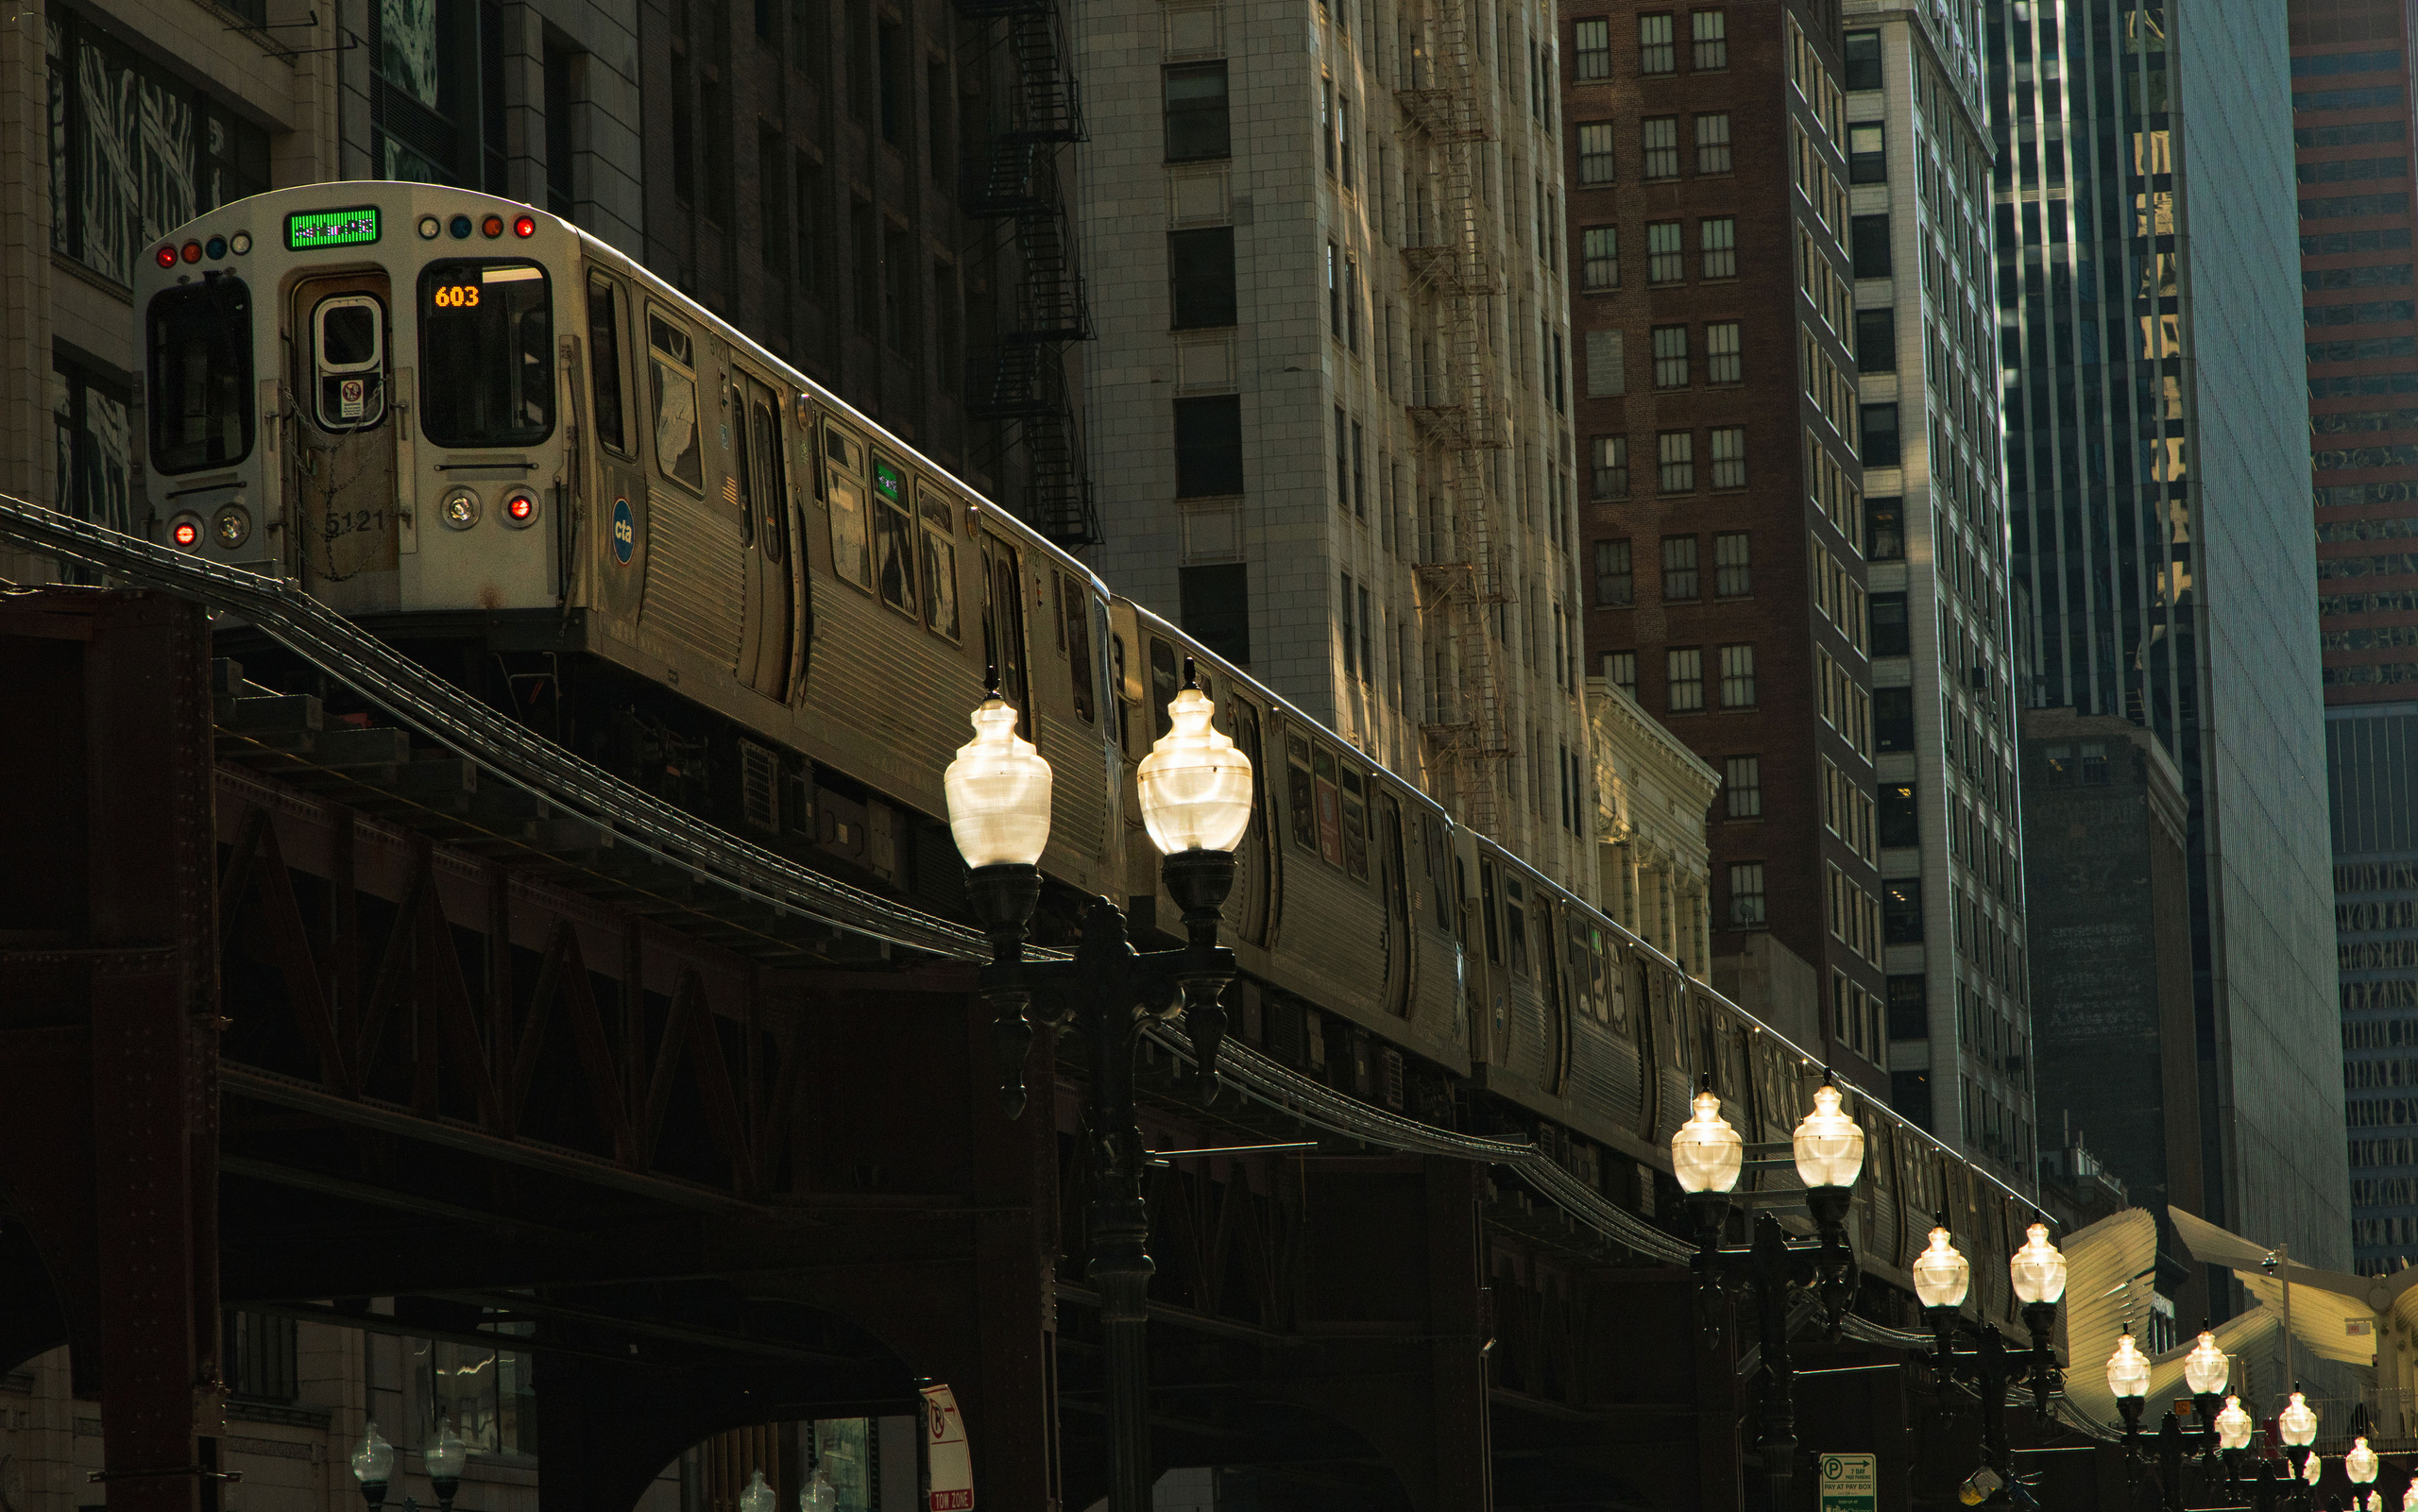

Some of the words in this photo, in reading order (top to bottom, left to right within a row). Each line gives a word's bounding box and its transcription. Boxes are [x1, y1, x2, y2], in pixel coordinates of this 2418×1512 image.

[435, 285, 479, 307] 603
[326, 510, 383, 534] 5121
[615, 519, 632, 544] cta
[935, 1493, 949, 1509] TOW
[952, 1491, 969, 1508] ZONE
